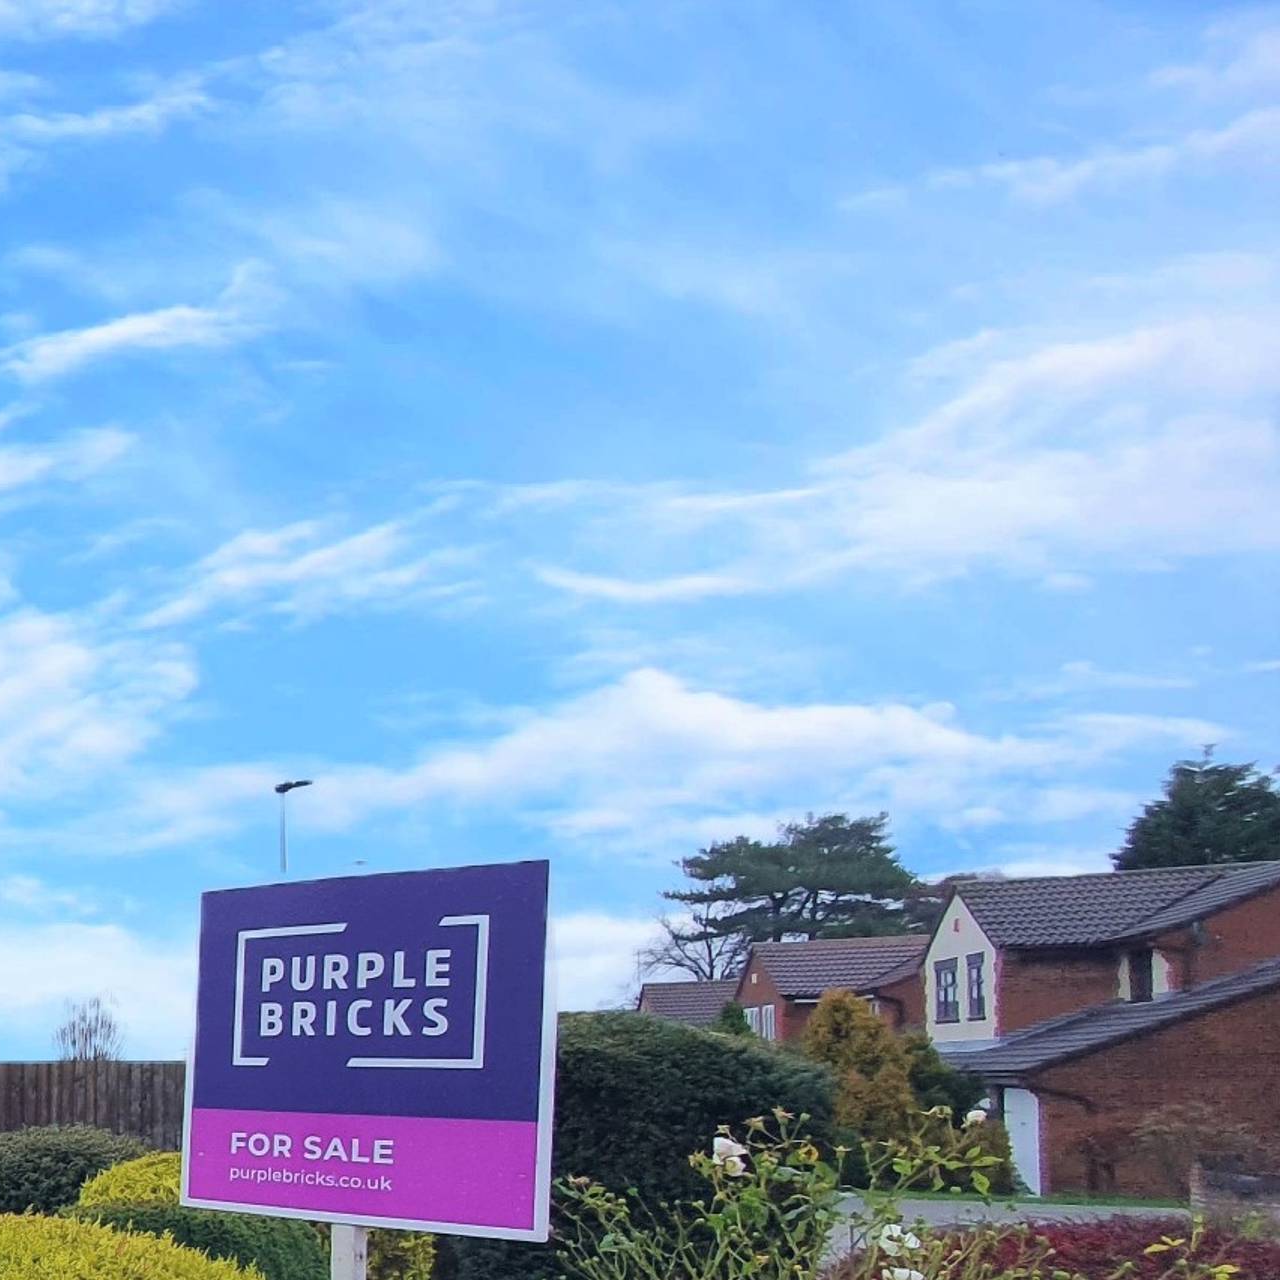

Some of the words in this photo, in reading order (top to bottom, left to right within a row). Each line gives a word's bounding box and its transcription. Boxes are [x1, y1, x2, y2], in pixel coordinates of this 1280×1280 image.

[261, 949, 452, 993] PURPLE
[259, 997, 449, 1037] BRICKS
[230, 1132, 293, 1158] FOR
[303, 1135, 394, 1165] SALE
[229, 1167, 393, 1191] purplebricks.co.uk
